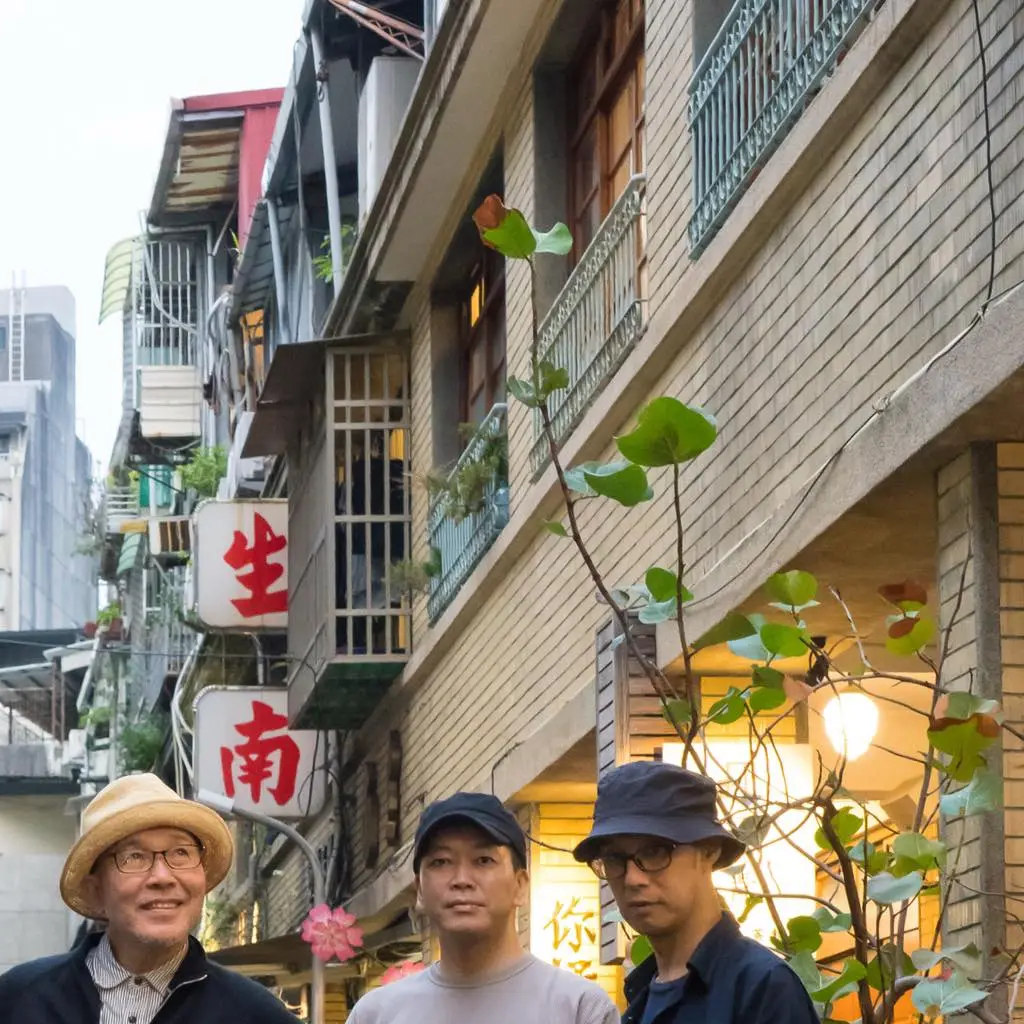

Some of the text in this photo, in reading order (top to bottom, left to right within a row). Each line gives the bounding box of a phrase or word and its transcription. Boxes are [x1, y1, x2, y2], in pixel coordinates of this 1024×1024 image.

[223, 511, 289, 618] 生
[220, 700, 301, 806] 南
[543, 896, 597, 980] 你
